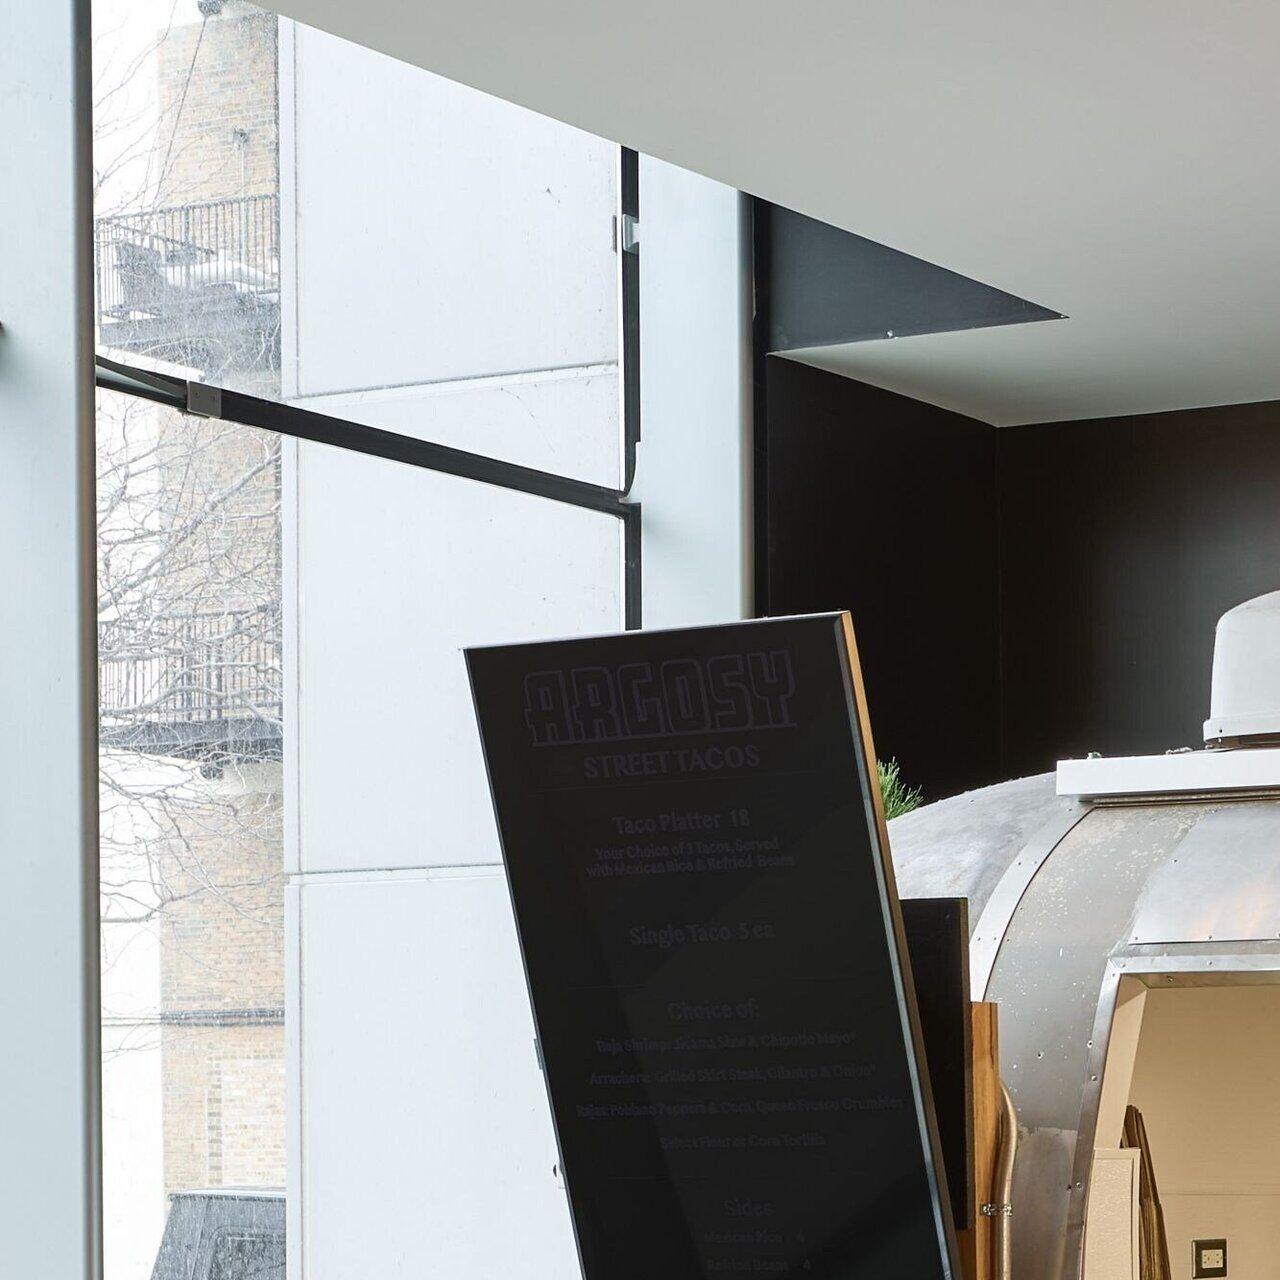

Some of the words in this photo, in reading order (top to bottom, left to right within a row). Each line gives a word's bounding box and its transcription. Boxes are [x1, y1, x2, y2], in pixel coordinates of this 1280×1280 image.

[524, 650, 797, 746] ARGOSY
[584, 751, 671, 778] STREET
[672, 745, 760, 772] TACOS
[612, 816, 657, 834] Taco
[659, 811, 721, 831] Platter
[729, 808, 750, 828] 18
[629, 925, 685, 948] Single
[687, 925, 730, 942] Taco
[667, 1000, 733, 1020] Choice
[723, 1197, 776, 1217] Sides
